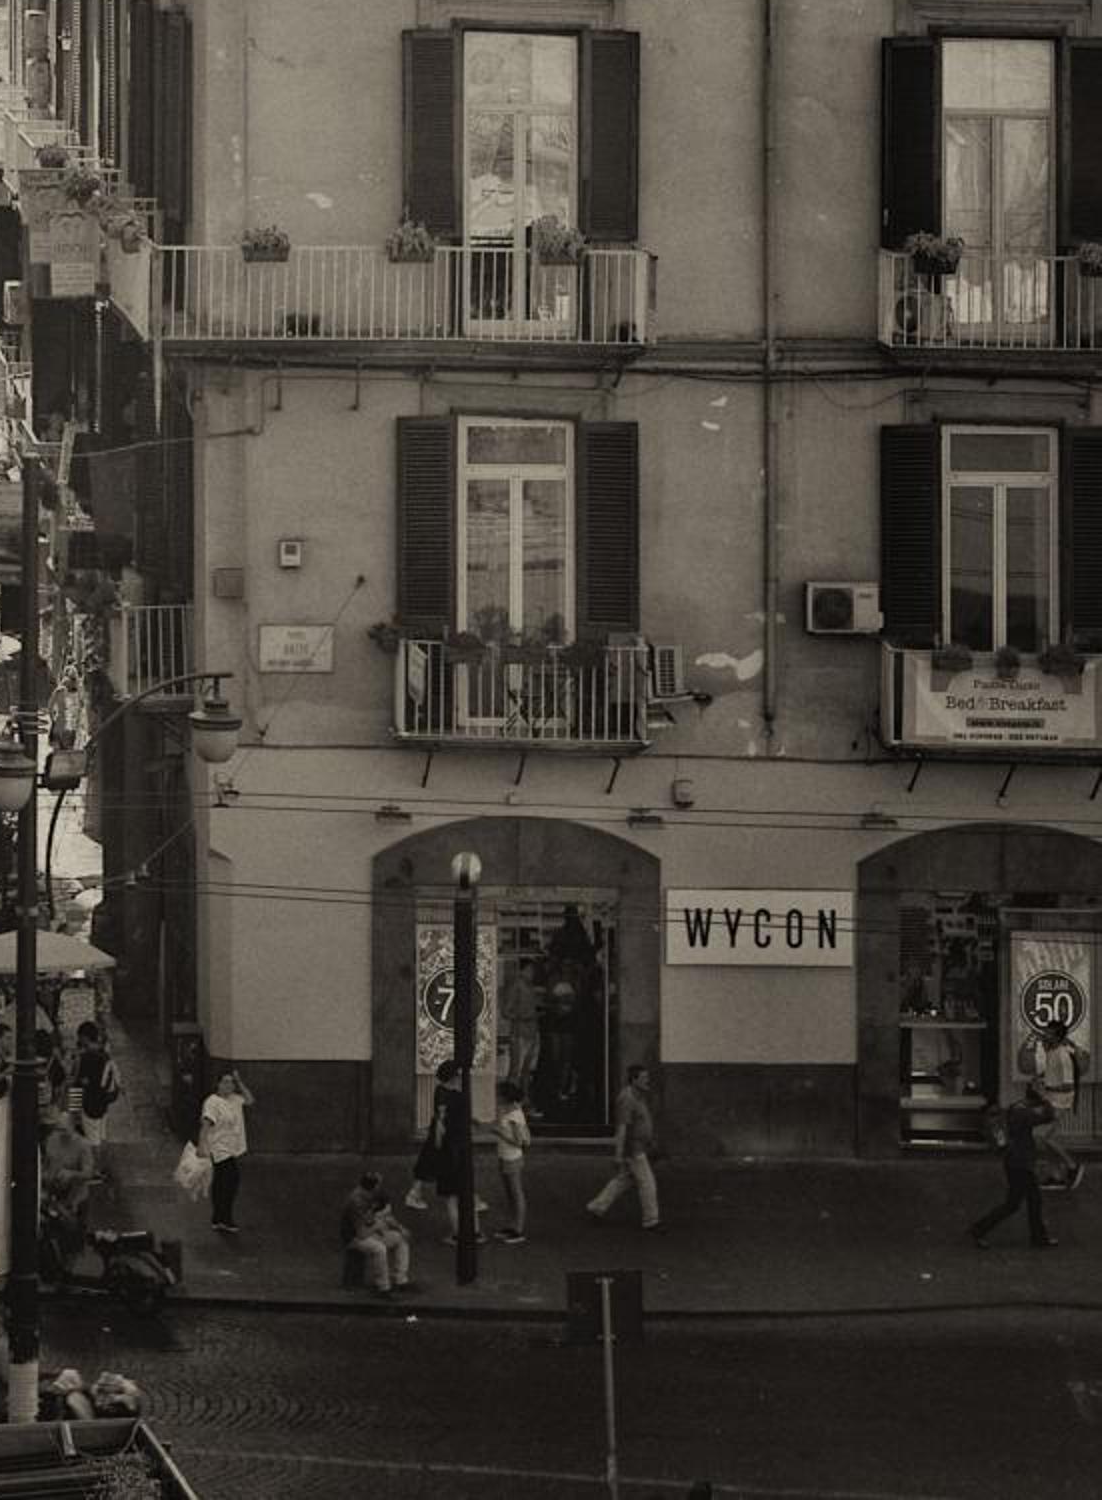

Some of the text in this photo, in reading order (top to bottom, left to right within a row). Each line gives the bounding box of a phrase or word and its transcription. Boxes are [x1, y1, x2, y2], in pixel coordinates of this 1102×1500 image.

[945, 695, 976, 710] Bed
[988, 696, 1068, 712] Breakfast
[684, 908, 837, 949] WYCON
